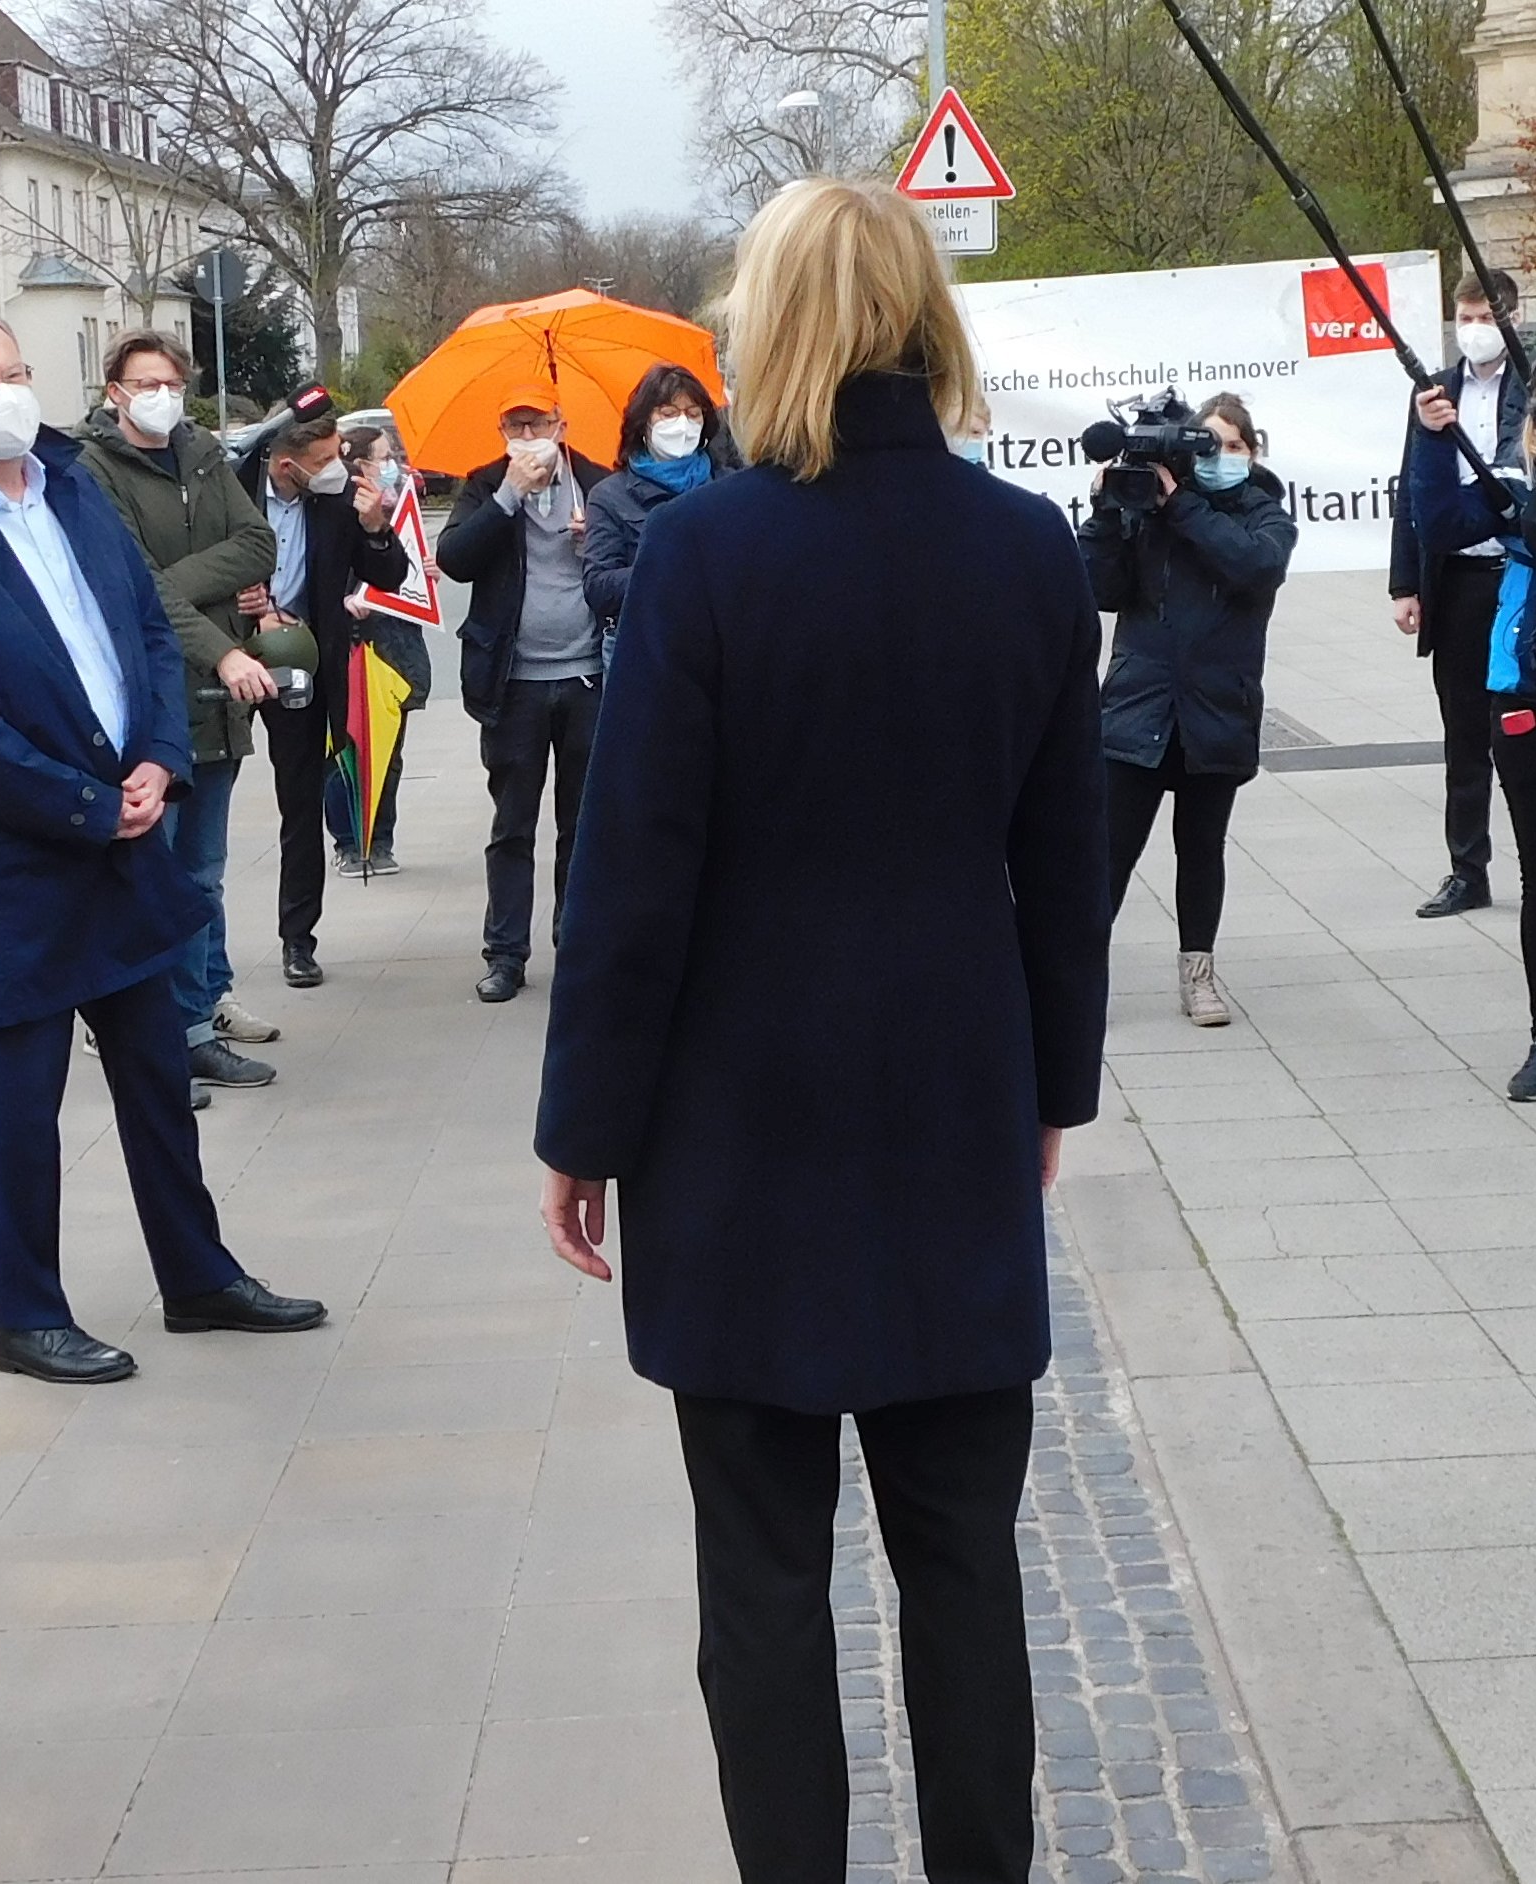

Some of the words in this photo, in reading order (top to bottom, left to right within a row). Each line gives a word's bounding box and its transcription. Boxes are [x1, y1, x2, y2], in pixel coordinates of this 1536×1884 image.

[926, 203, 978, 219] stellen-
[935, 226, 969, 242] fahrt
[983, 369, 1040, 392] ische
[1049, 362, 1178, 390] Hochschule
[1188, 359, 1299, 382] Hannover
[987, 430, 1090, 469] itzen
[1288, 475, 1400, 523] ltarif
